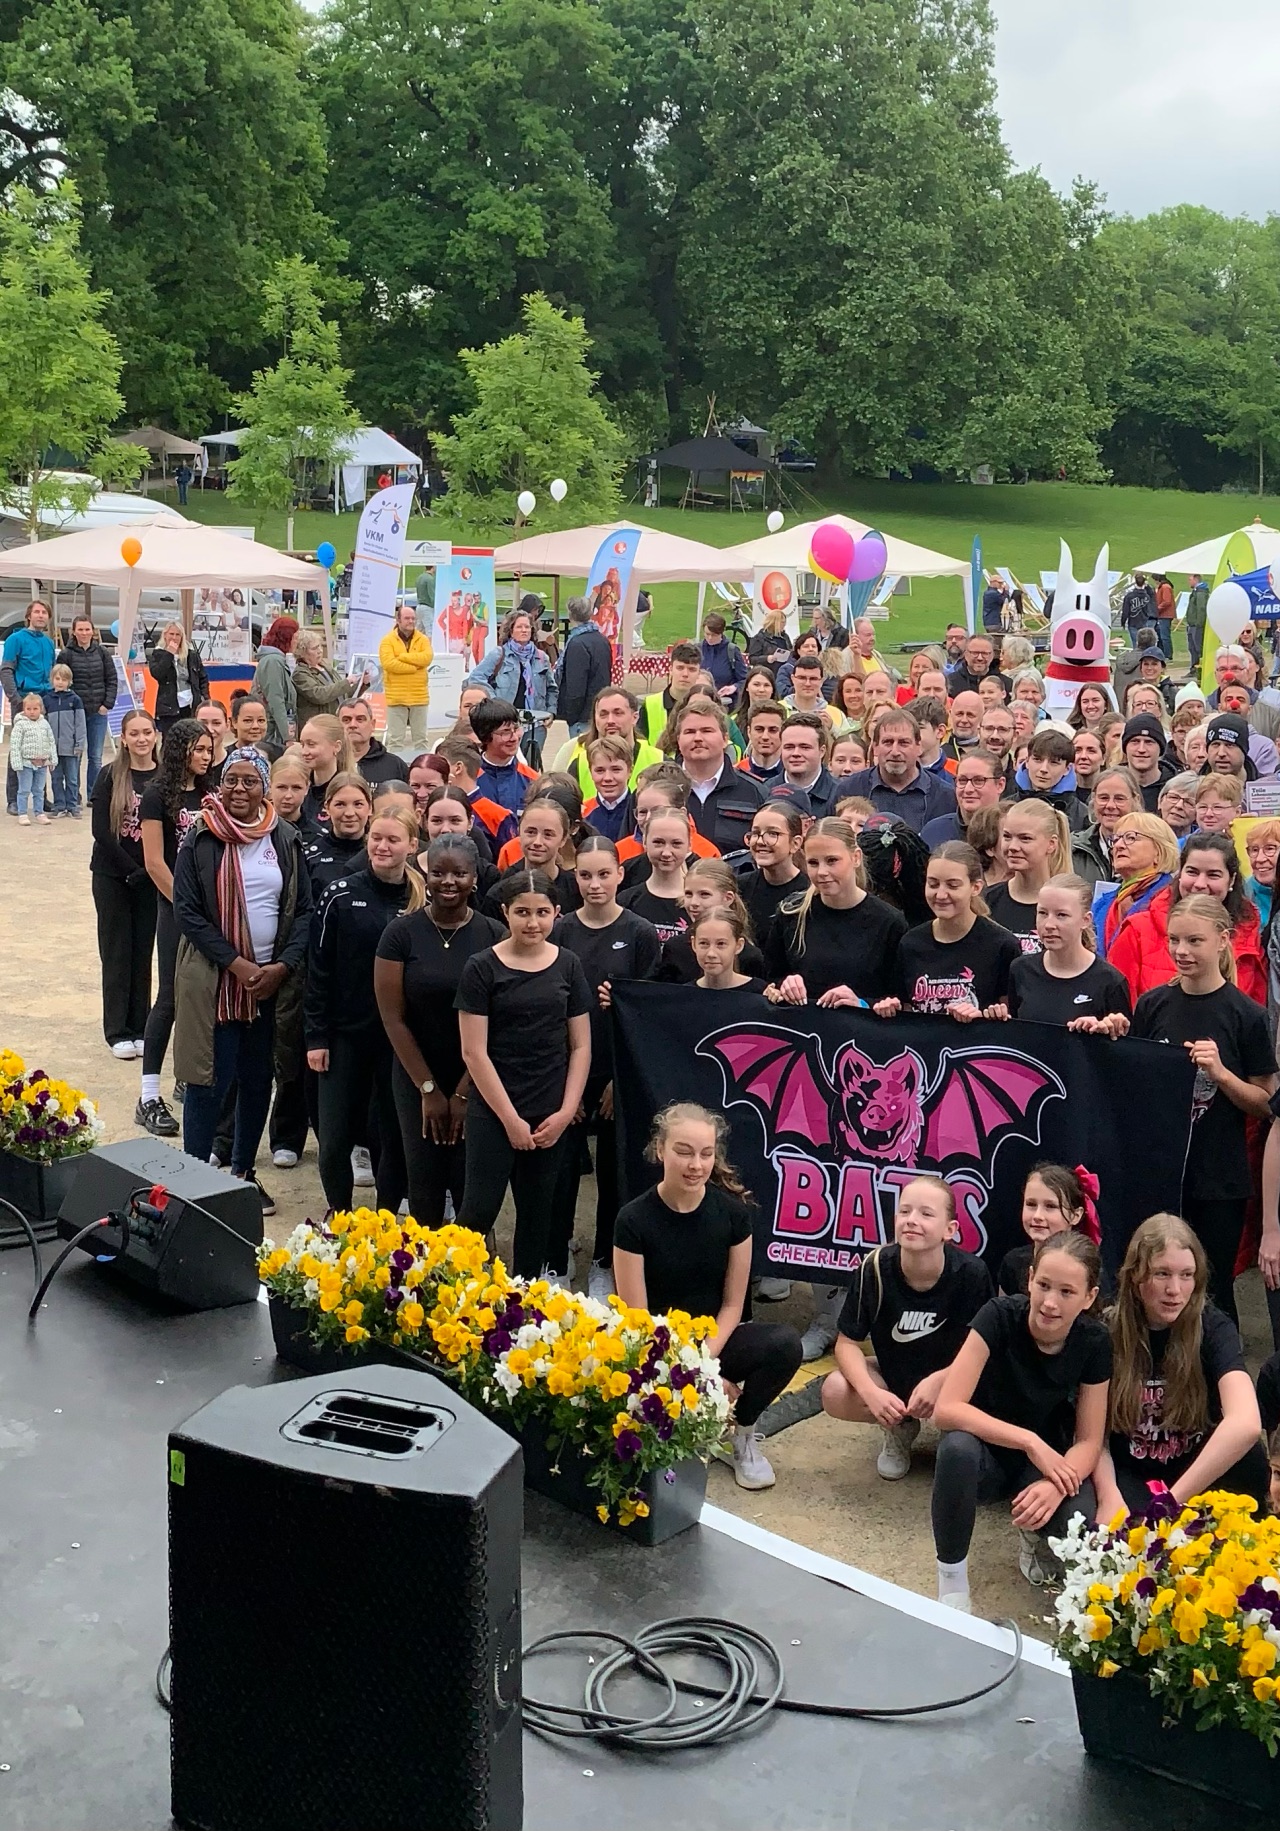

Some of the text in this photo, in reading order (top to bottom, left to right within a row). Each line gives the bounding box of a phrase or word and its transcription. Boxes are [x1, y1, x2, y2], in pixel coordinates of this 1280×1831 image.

[365, 529, 384, 543] VKM
[914, 976, 970, 1002] Queens
[897, 1310, 938, 1331] NIKE
